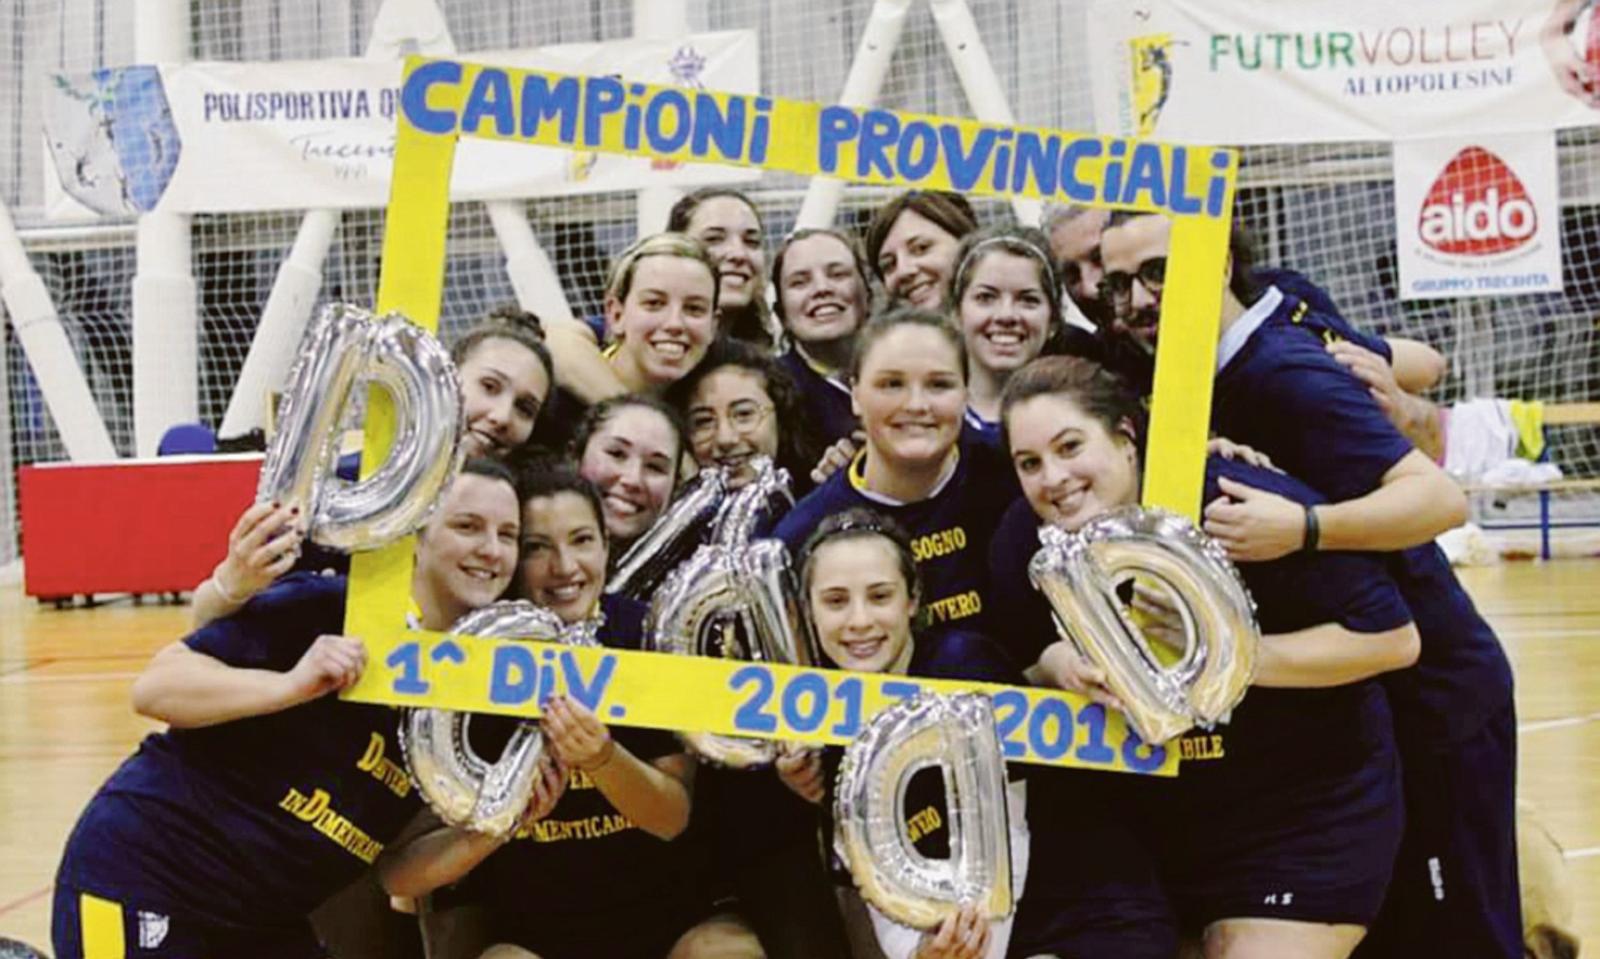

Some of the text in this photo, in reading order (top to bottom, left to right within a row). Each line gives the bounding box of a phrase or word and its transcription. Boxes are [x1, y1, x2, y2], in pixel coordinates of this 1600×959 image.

[203, 87, 400, 122] POLISPORTIVA Q
[401, 60, 1230, 217] CAMPiONi PROViNCiALi
[1421, 188, 1535, 244] aido
[910, 526, 967, 562] SOGNO
[728, 666, 922, 736] 201
[1178, 735, 1225, 760] BILE
